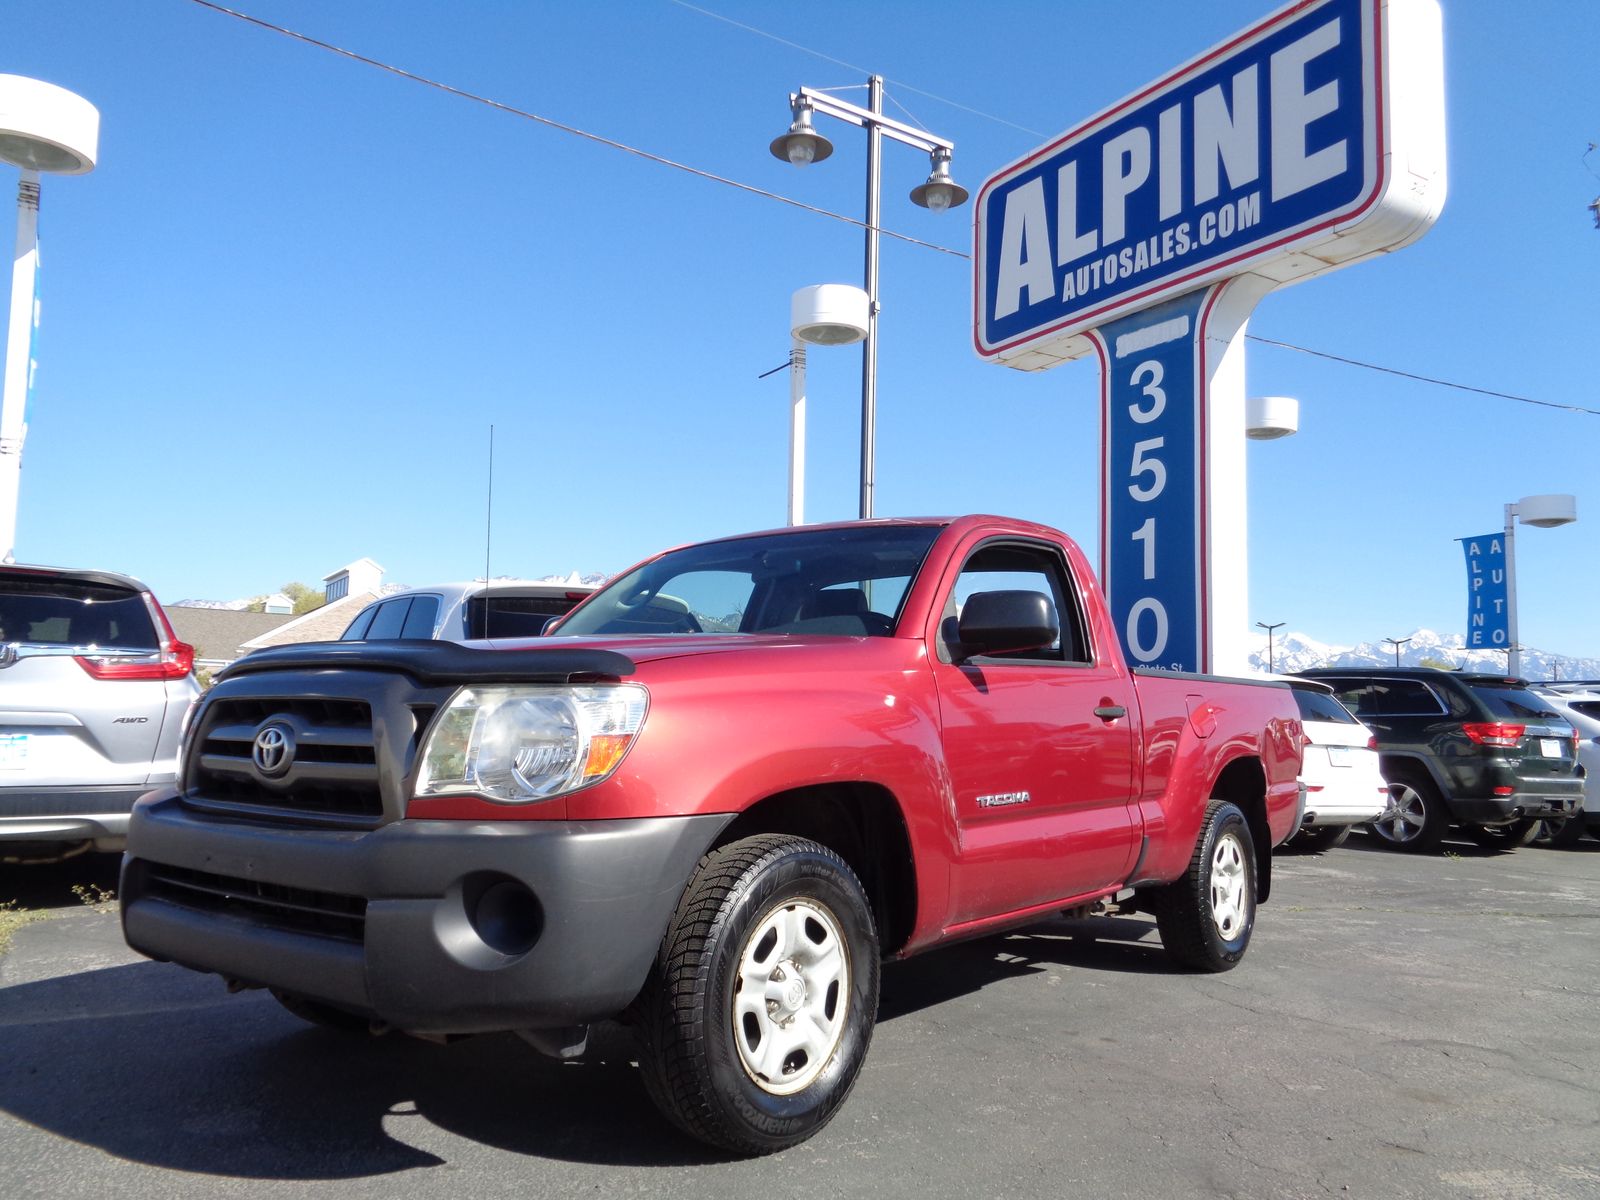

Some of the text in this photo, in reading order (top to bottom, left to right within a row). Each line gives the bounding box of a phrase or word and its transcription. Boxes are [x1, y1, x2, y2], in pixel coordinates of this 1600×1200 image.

[994, 17, 1348, 321] ALPINE
[1062, 191, 1261, 303] AUTOSALES.COM
[1126, 360, 1169, 663] 3510
[1469, 542, 1484, 645] ALPINE
[1490, 539, 1505, 644] AUTO
[976, 791, 1031, 808] TACOMA
